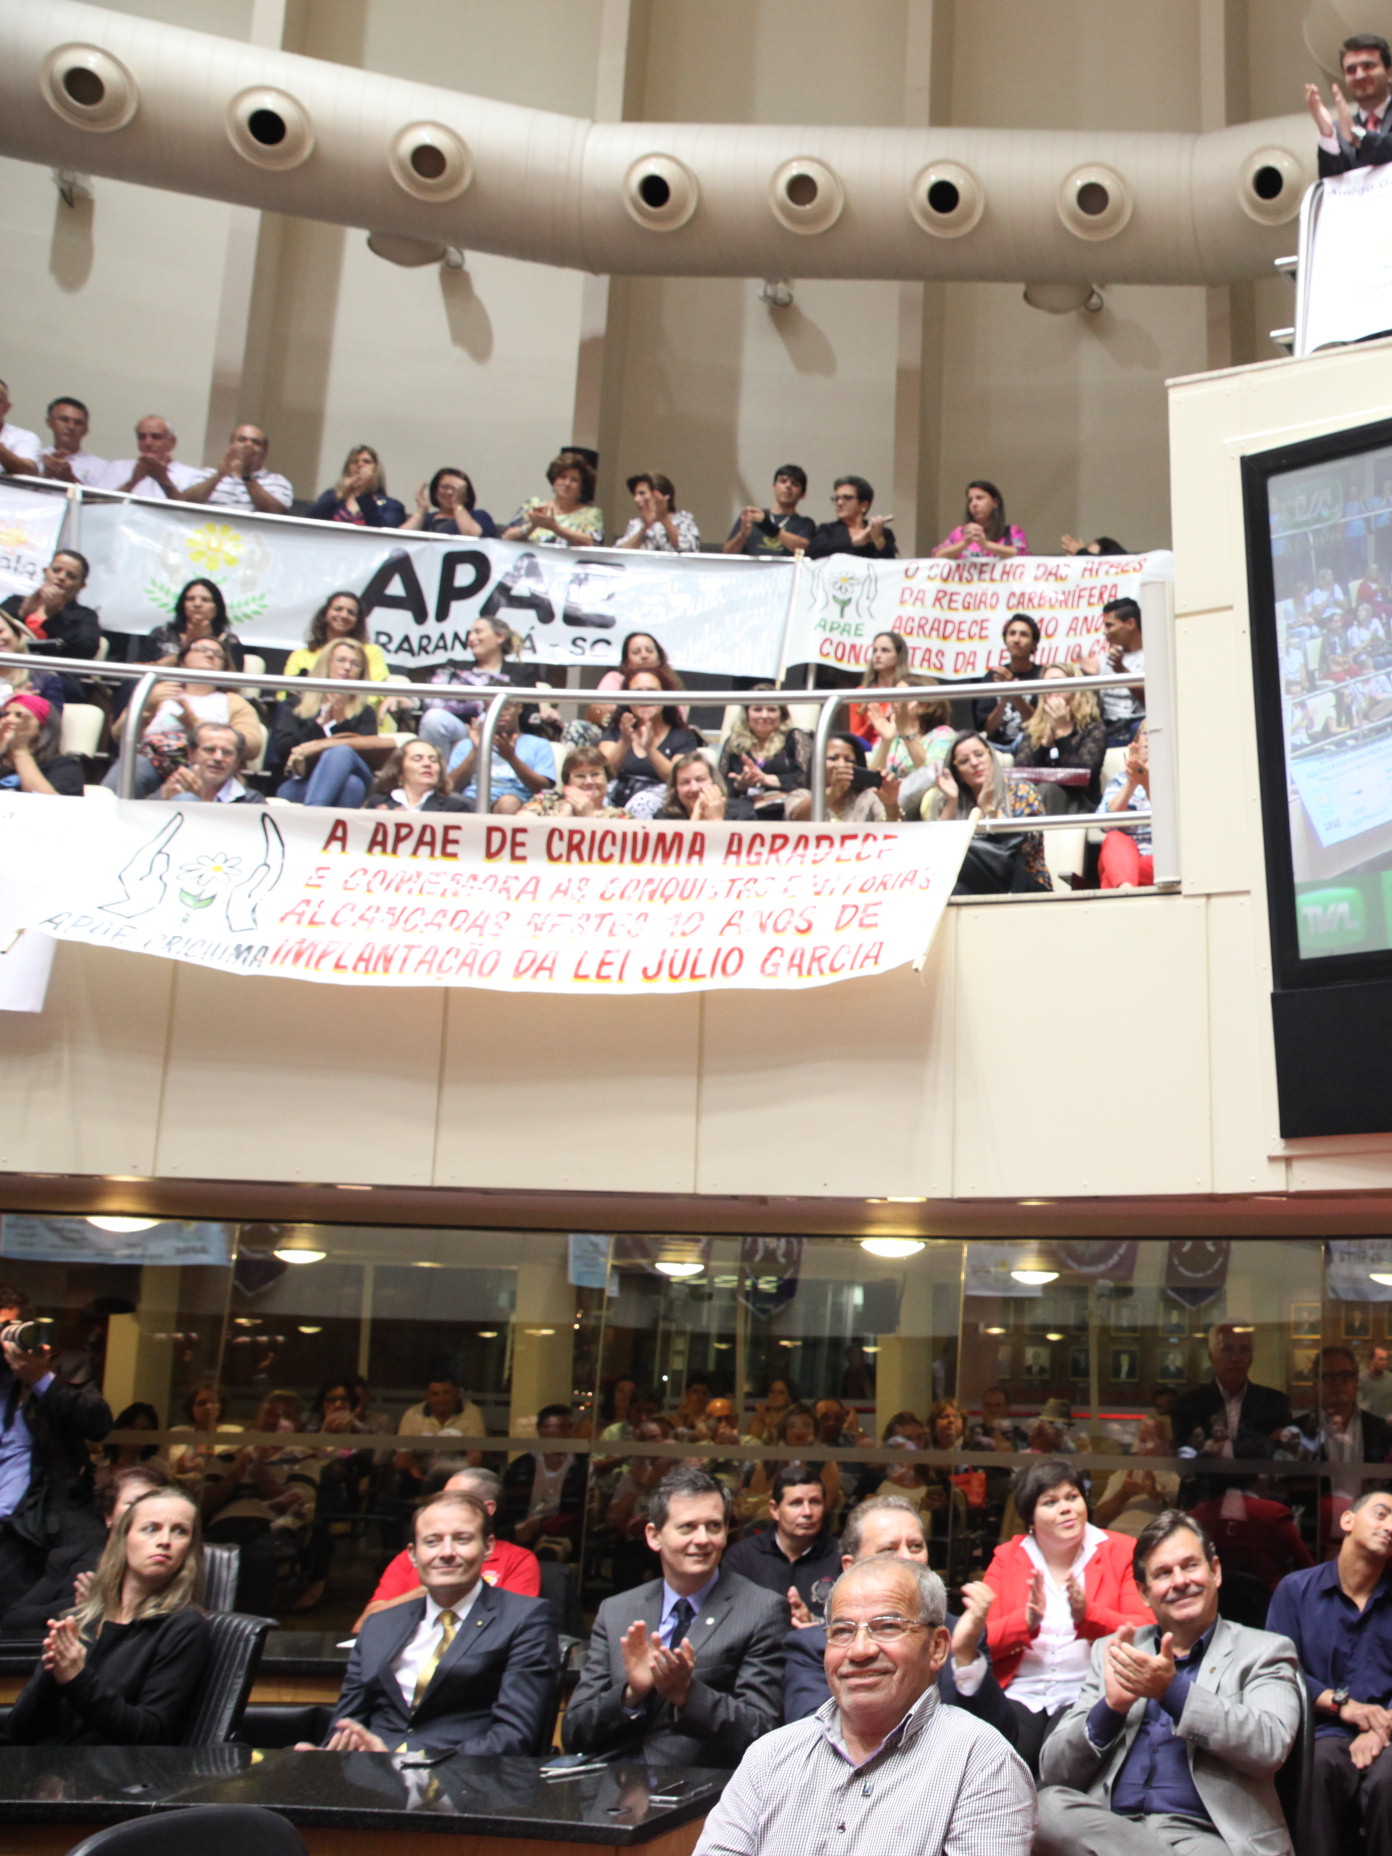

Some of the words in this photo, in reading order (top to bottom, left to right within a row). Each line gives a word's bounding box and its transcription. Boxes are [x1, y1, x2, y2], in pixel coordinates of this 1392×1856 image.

[904, 562, 920, 580] O
[928, 562, 1025, 584] CONSELHO
[359, 547, 627, 629] APAE
[900, 587, 928, 606] DA
[932, 588, 1000, 611] REGIÃO
[1006, 584, 1119, 611] CARBONÍFERA
[814, 617, 866, 637] APAE
[891, 615, 990, 641] AGRADECE
[570, 636, 613, 657] SC
[954, 650, 976, 673] DA
[321, 819, 349, 852] A
[365, 821, 463, 859] APAE
[485, 826, 529, 863] DE
[545, 826, 707, 865] CRICIÚMA
[303, 866, 331, 889] E
[667, 911, 706, 937] 10
[718, 905, 817, 936] ANOS
[834, 901, 883, 932] DE
[270, 936, 502, 981] IMPLANTAÇÃO
[511, 948, 559, 981] DA
[571, 948, 632, 982] LEI
[759, 940, 884, 979] GARCIA
